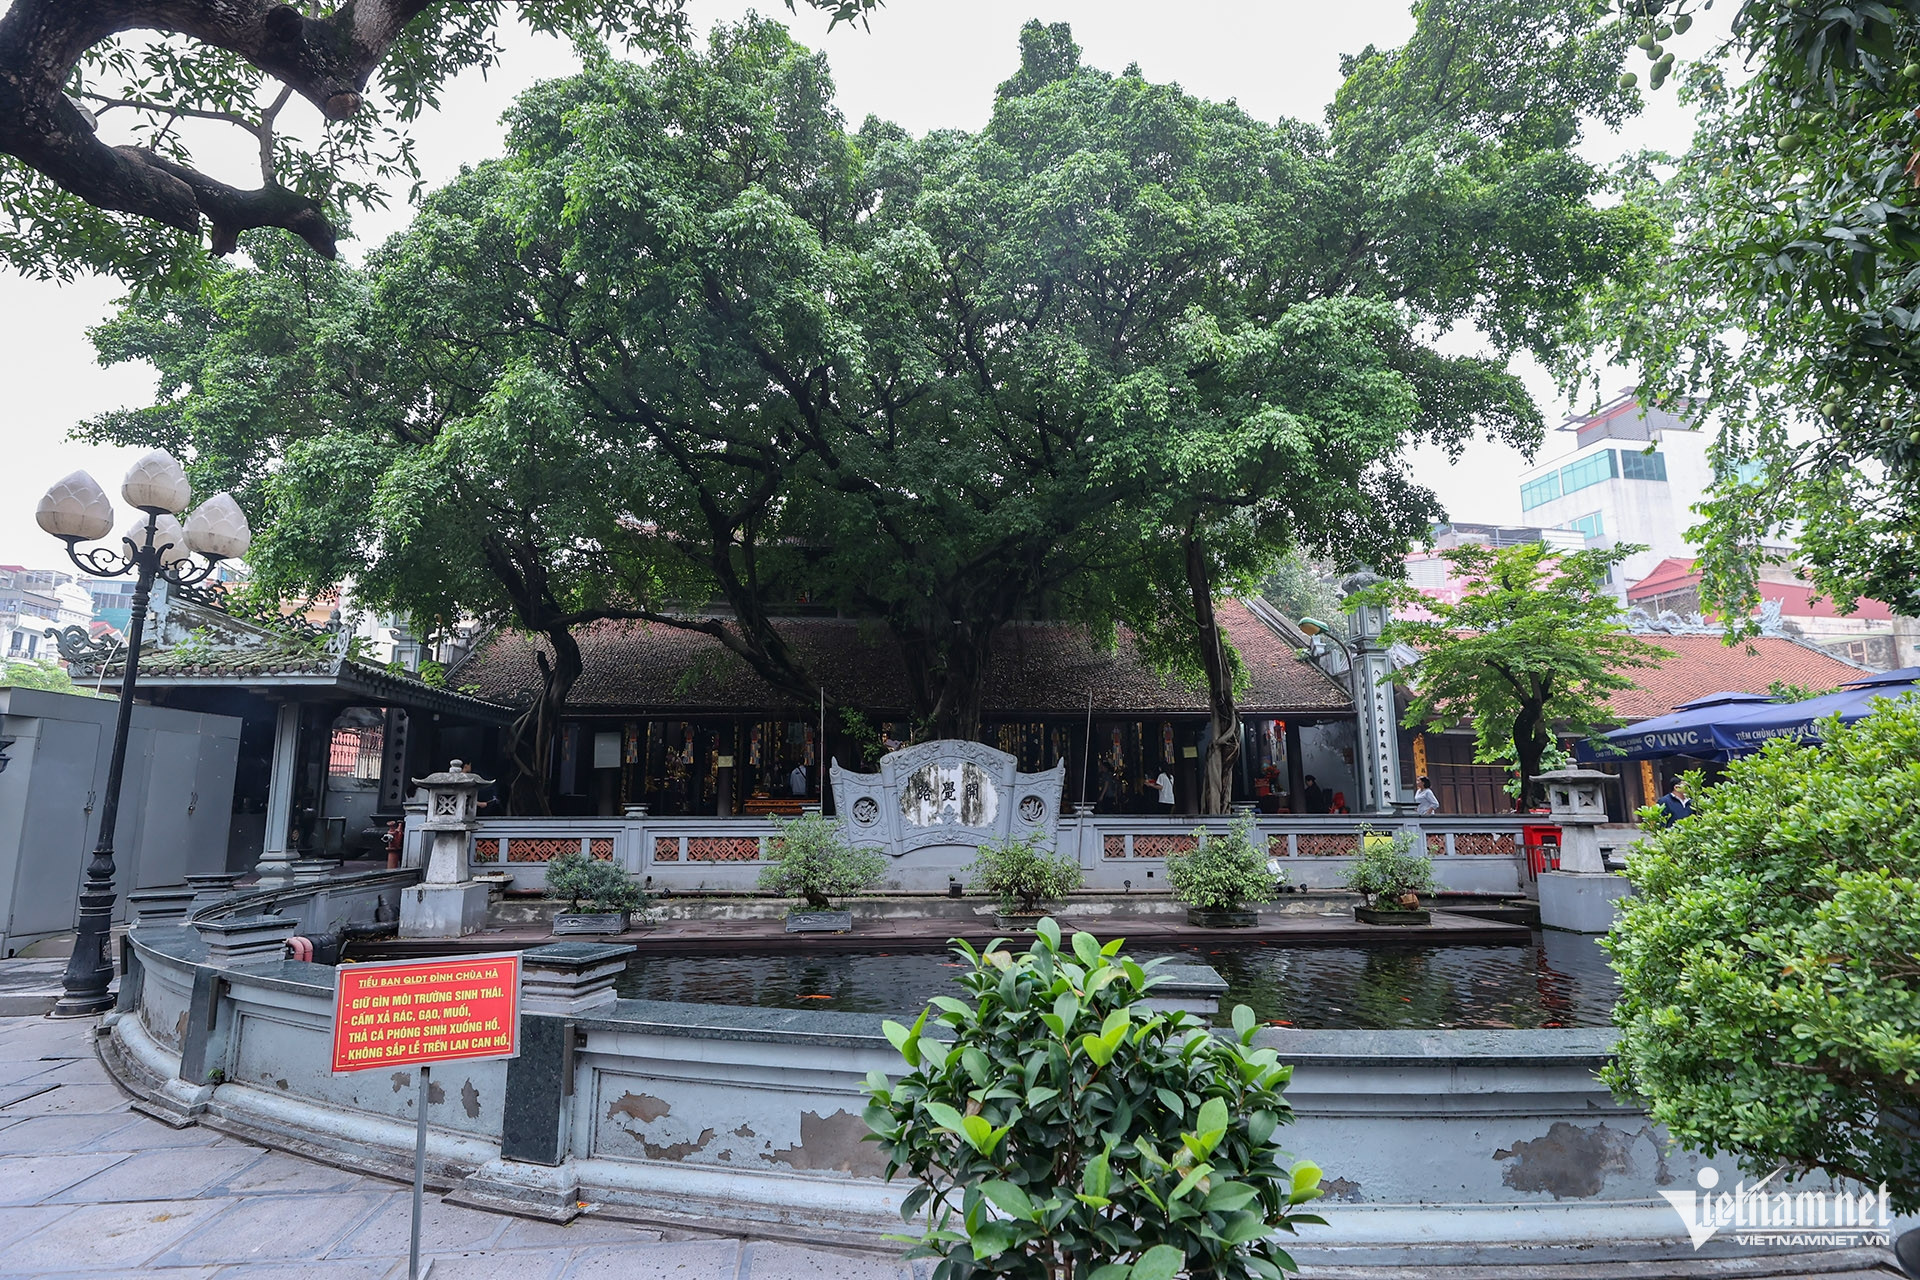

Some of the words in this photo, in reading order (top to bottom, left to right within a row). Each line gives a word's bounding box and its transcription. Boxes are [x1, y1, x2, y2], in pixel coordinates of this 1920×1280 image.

[1657, 731, 1698, 747] VNVC
[359, 975, 378, 988] TIỂU
[381, 977, 401, 986] BAN
[404, 975, 428, 984] QLDT
[430, 972, 453, 982] ĐÌNH
[456, 969, 482, 980] CHÙA
[485, 967, 498, 978] HÀ
[352, 996, 371, 1009] GIỮ
[372, 994, 389, 1007] GÌN
[392, 993, 411, 1006] MÔI
[414, 989, 452, 1004] TRƯỜNG
[455, 989, 478, 1000] SINH
[481, 986, 504, 998] THÁI.
[351, 1012, 374, 1026] CẤM
[377, 1010, 390, 1024] XẢ
[393, 1008, 415, 1023] RÁC,
[419, 1008, 441, 1022] GẠO,
[443, 1003, 471, 1018] MUỐI,
[349, 1028, 367, 1043] THẢ
[371, 1027, 384, 1041] CÁ
[387, 1026, 420, 1039] PHÓNG
[424, 1024, 447, 1036] SINH
[450, 1019, 482, 1034] XUỐNG
[348, 1046, 383, 1060] KHÔNG
[423, 1040, 447, 1053] TRÊN
[450, 1039, 468, 1050] LAN
[472, 1037, 491, 1048] CAN
